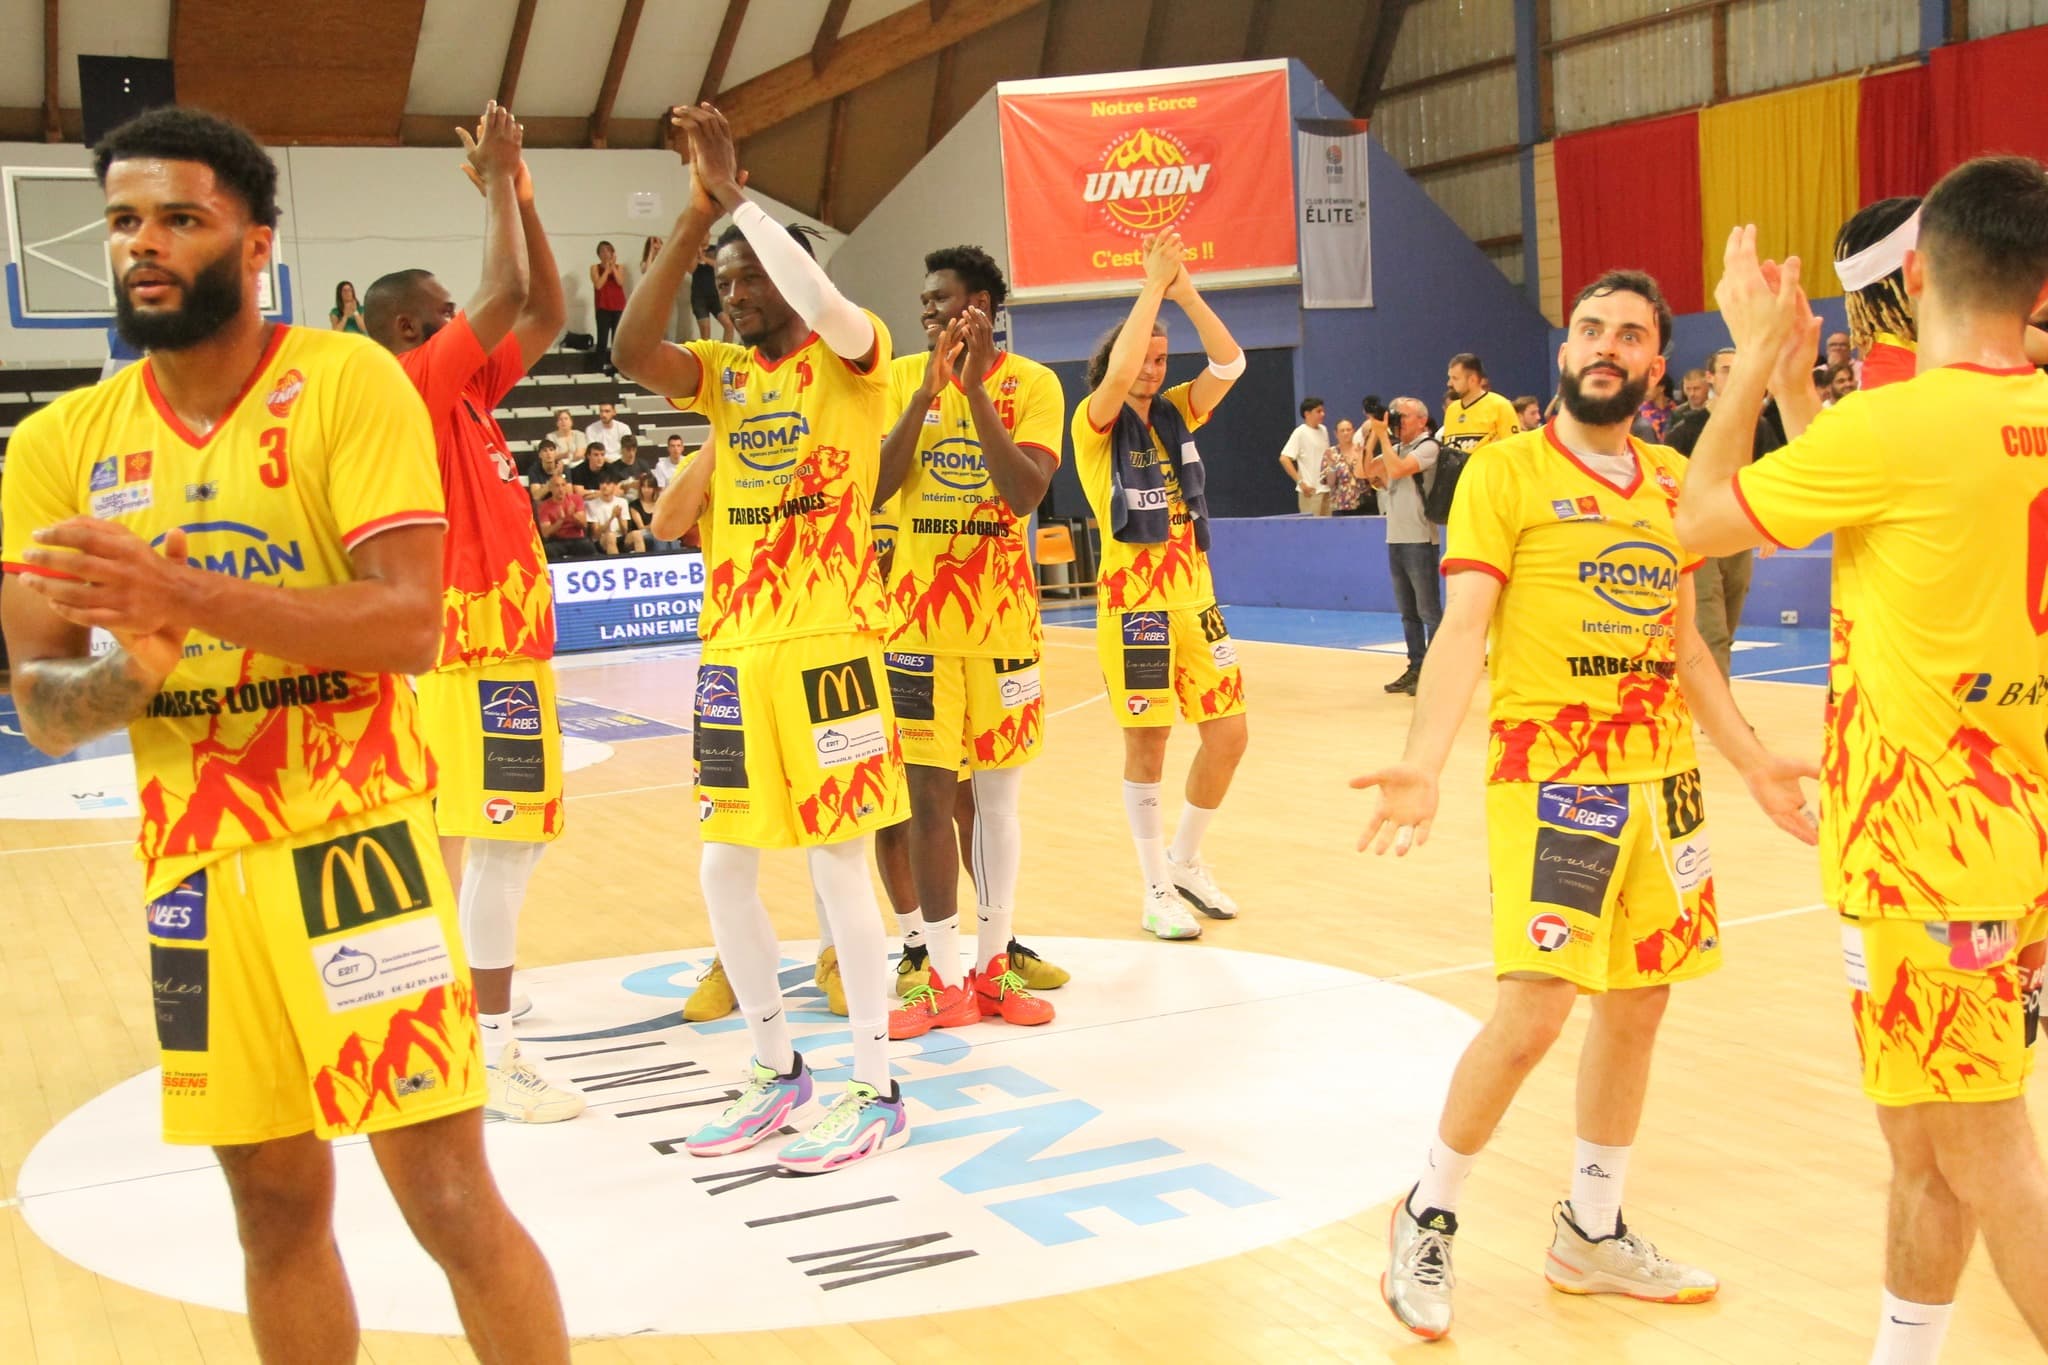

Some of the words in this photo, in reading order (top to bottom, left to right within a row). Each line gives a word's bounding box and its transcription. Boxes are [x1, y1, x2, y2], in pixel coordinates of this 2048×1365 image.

[1091, 101, 1144, 117] Notre
[1148, 95, 1198, 112] Force
[1083, 163, 1211, 202] UNION
[1306, 205, 1353, 223] ÉLITE
[1092, 250, 1144, 269] C'est
[1202, 241, 1214, 259] !!
[729, 416, 811, 451] PROMAN
[2000, 424, 2048, 458] COU
[258, 426, 290, 489] 3
[921, 450, 989, 471] PROMA
[922, 491, 956, 503] Intérim
[728, 506, 771, 525] TARBES
[911, 518, 958, 535] TARBES
[566, 571, 617, 594] SOS
[623, 562, 704, 590] Pare-B
[634, 599, 702, 619] IDRON
[600, 621, 698, 640] LANNEME
[1582, 619, 1633, 635] Intérim
[1132, 632, 1166, 642] TARBES
[889, 652, 926, 667] TARBES
[225, 670, 350, 715] LOURDES
[702, 704, 740, 719] TARBES
[497, 717, 539, 730] TARBES
[487, 752, 544, 764] Lourde
[1558, 803, 1618, 828] TARBES
[1579, 1167, 1612, 1179] PEAK
